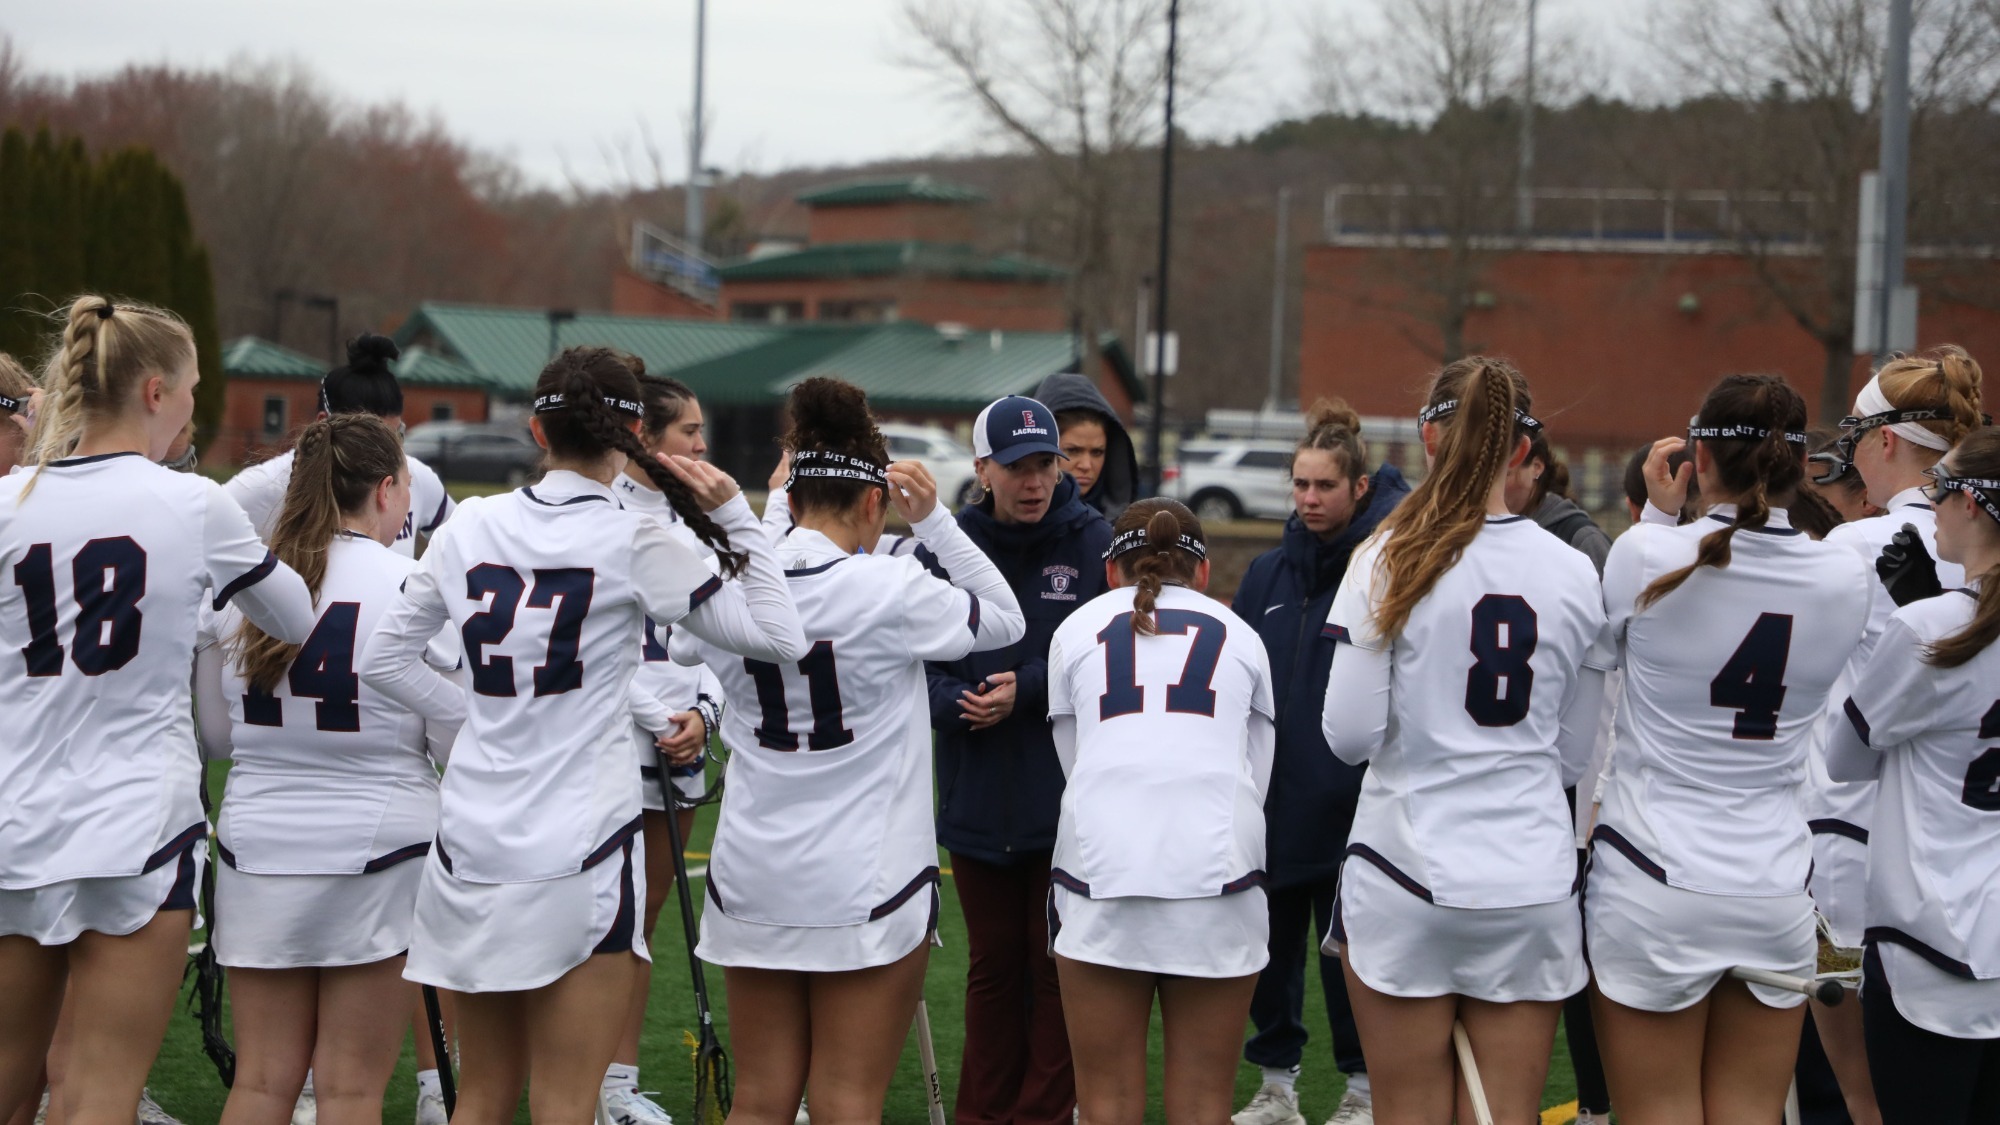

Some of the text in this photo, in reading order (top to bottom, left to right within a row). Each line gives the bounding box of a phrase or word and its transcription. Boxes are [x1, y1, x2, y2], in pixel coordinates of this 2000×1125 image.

[549, 394, 565, 403] GA
[1021, 410, 1035, 427] E
[1900, 410, 1937, 421] STX
[1012, 428, 1048, 437] LACROSSE
[1701, 428, 1719, 437] GAIT
[1722, 428, 1736, 437] GA
[1736, 424, 1755, 435] AIT
[850, 457, 875, 473] GAIT
[1986, 503, 2000, 522] GA
[14, 535, 147, 677] 18
[462, 562, 595, 698] 27
[1096, 608, 1227, 722] 17
[1464, 593, 1538, 727] 8
[1710, 612, 1793, 740] 4
[743, 640, 854, 752] 11
